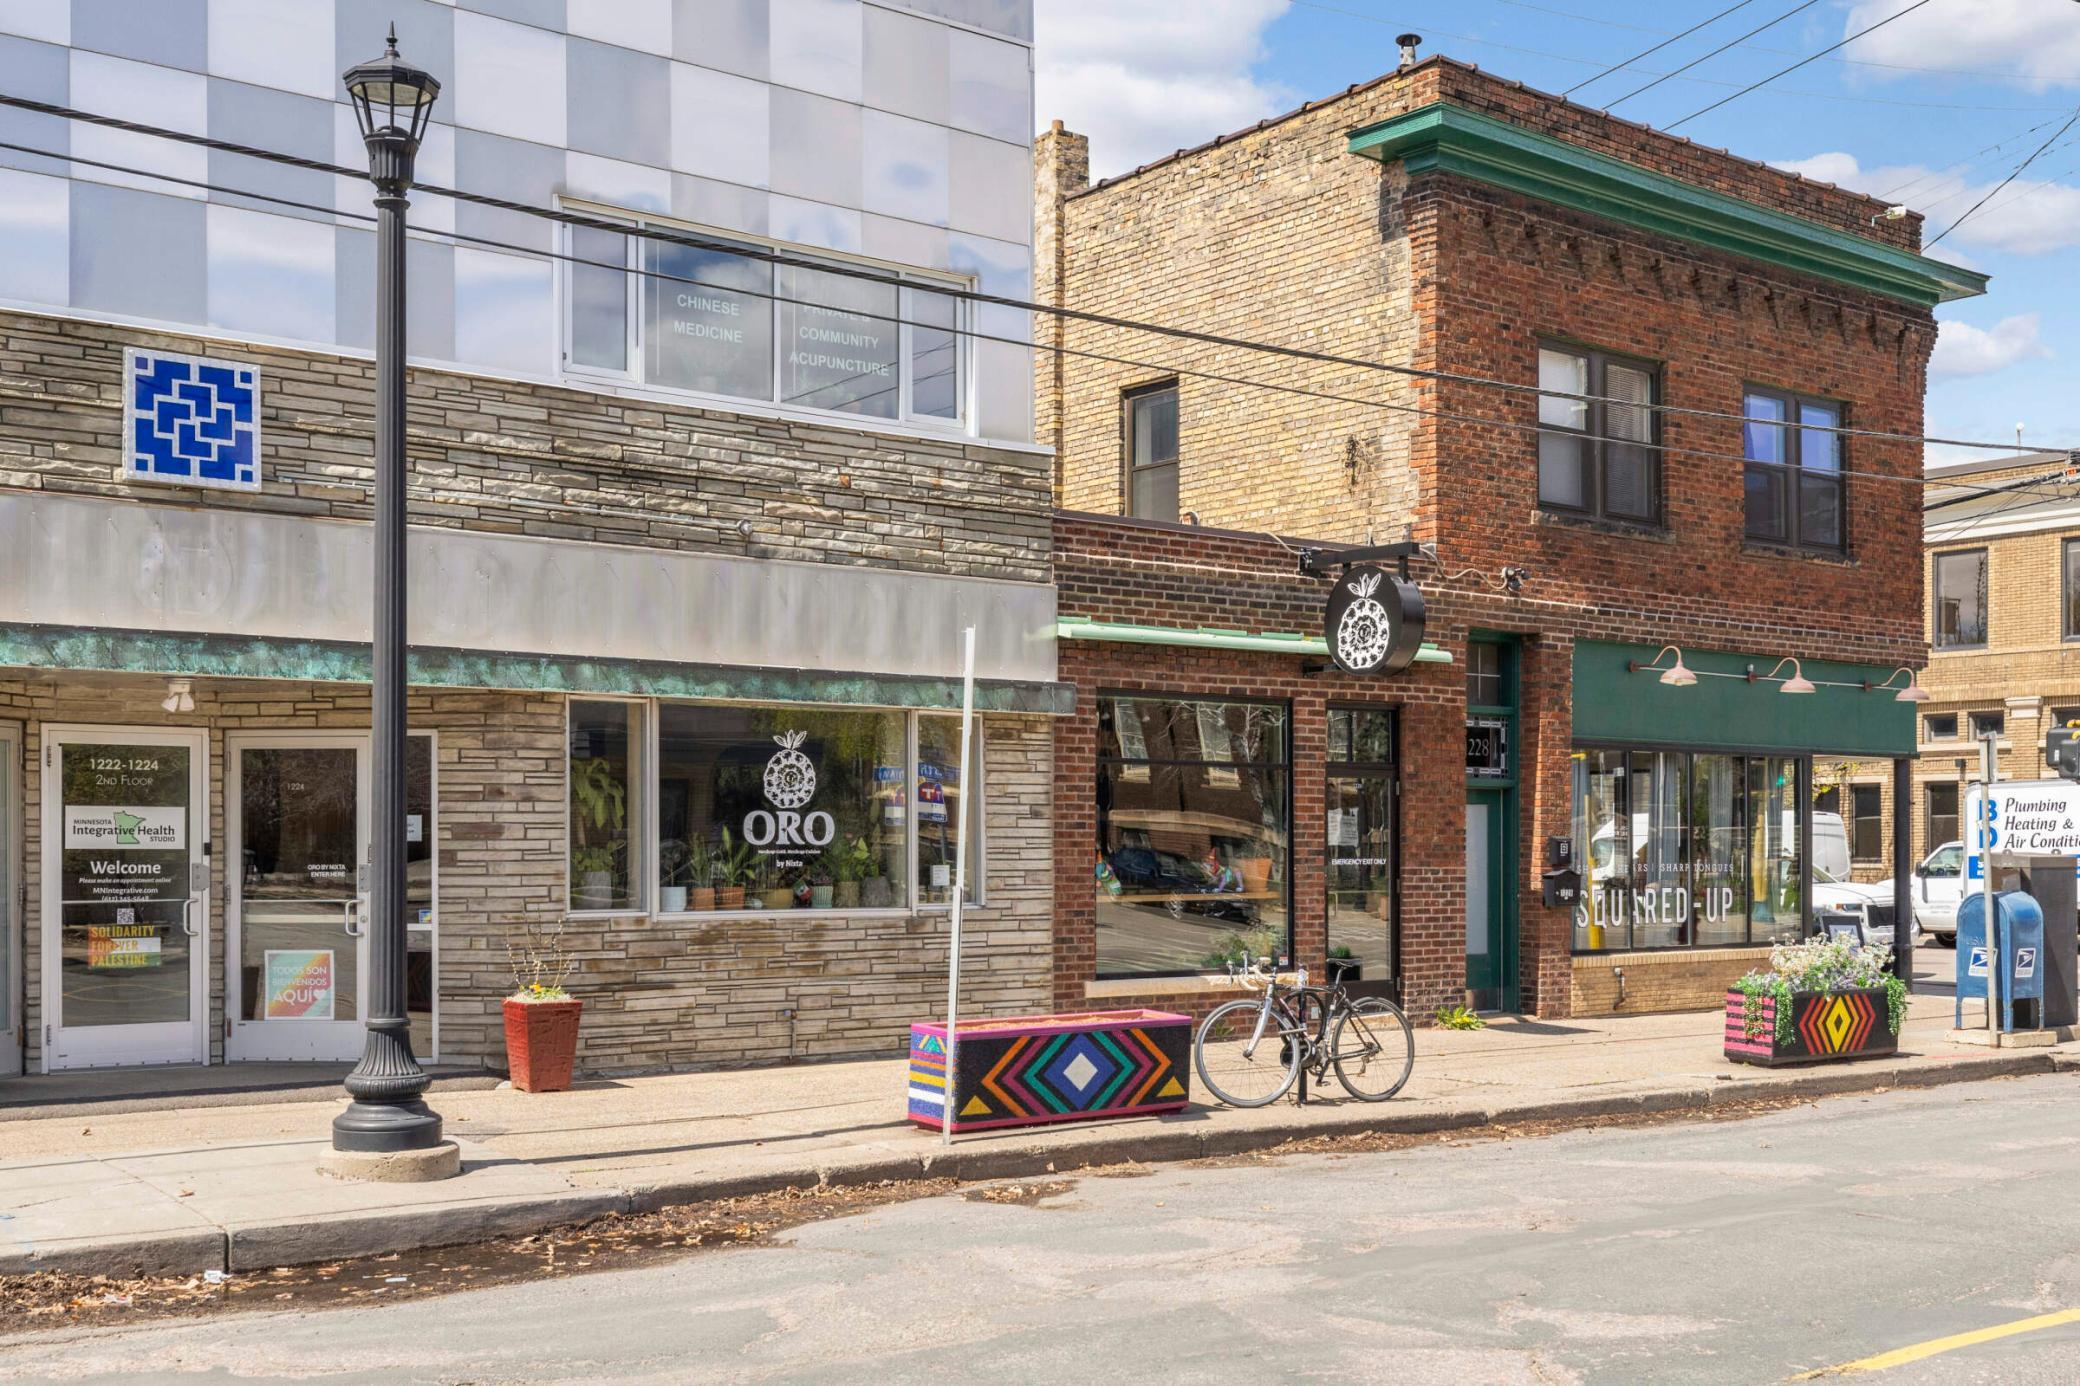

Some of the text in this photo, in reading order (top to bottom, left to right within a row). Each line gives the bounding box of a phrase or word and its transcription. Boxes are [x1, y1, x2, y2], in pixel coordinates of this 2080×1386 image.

[677, 294, 740, 316] CHINESE
[673, 320, 743, 343] MEDICINE
[800, 326, 879, 349] COMMUNITY
[788, 351, 889, 376] ACUPUNCTURE
[89, 758, 159, 771] 1222-1224
[2004, 797, 2067, 814] Plumbing
[743, 809, 835, 846] ORO
[2004, 815, 2074, 832] Heating &
[72, 825, 176, 838] Integrative Health
[2004, 832, 2080, 849] Air Conditi
[90, 860, 161, 875] Welcome
[776, 860, 785, 868] by
[1659, 863, 1690, 873] SHARP
[1694, 863, 1734, 873] TONGUES
[92, 887, 158, 895] MNIntegrative.com
[1576, 887, 1734, 928] SQUARED-UP
[91, 925, 155, 937] SOLIDARITY
[91, 940, 139, 953] FOREVER
[91, 953, 145, 967] PALESTINE
[271, 966, 327, 975] TODOS SON
[271, 978, 327, 986] BIENVENIDOS
[273, 986, 313, 1006] AQUÍ
